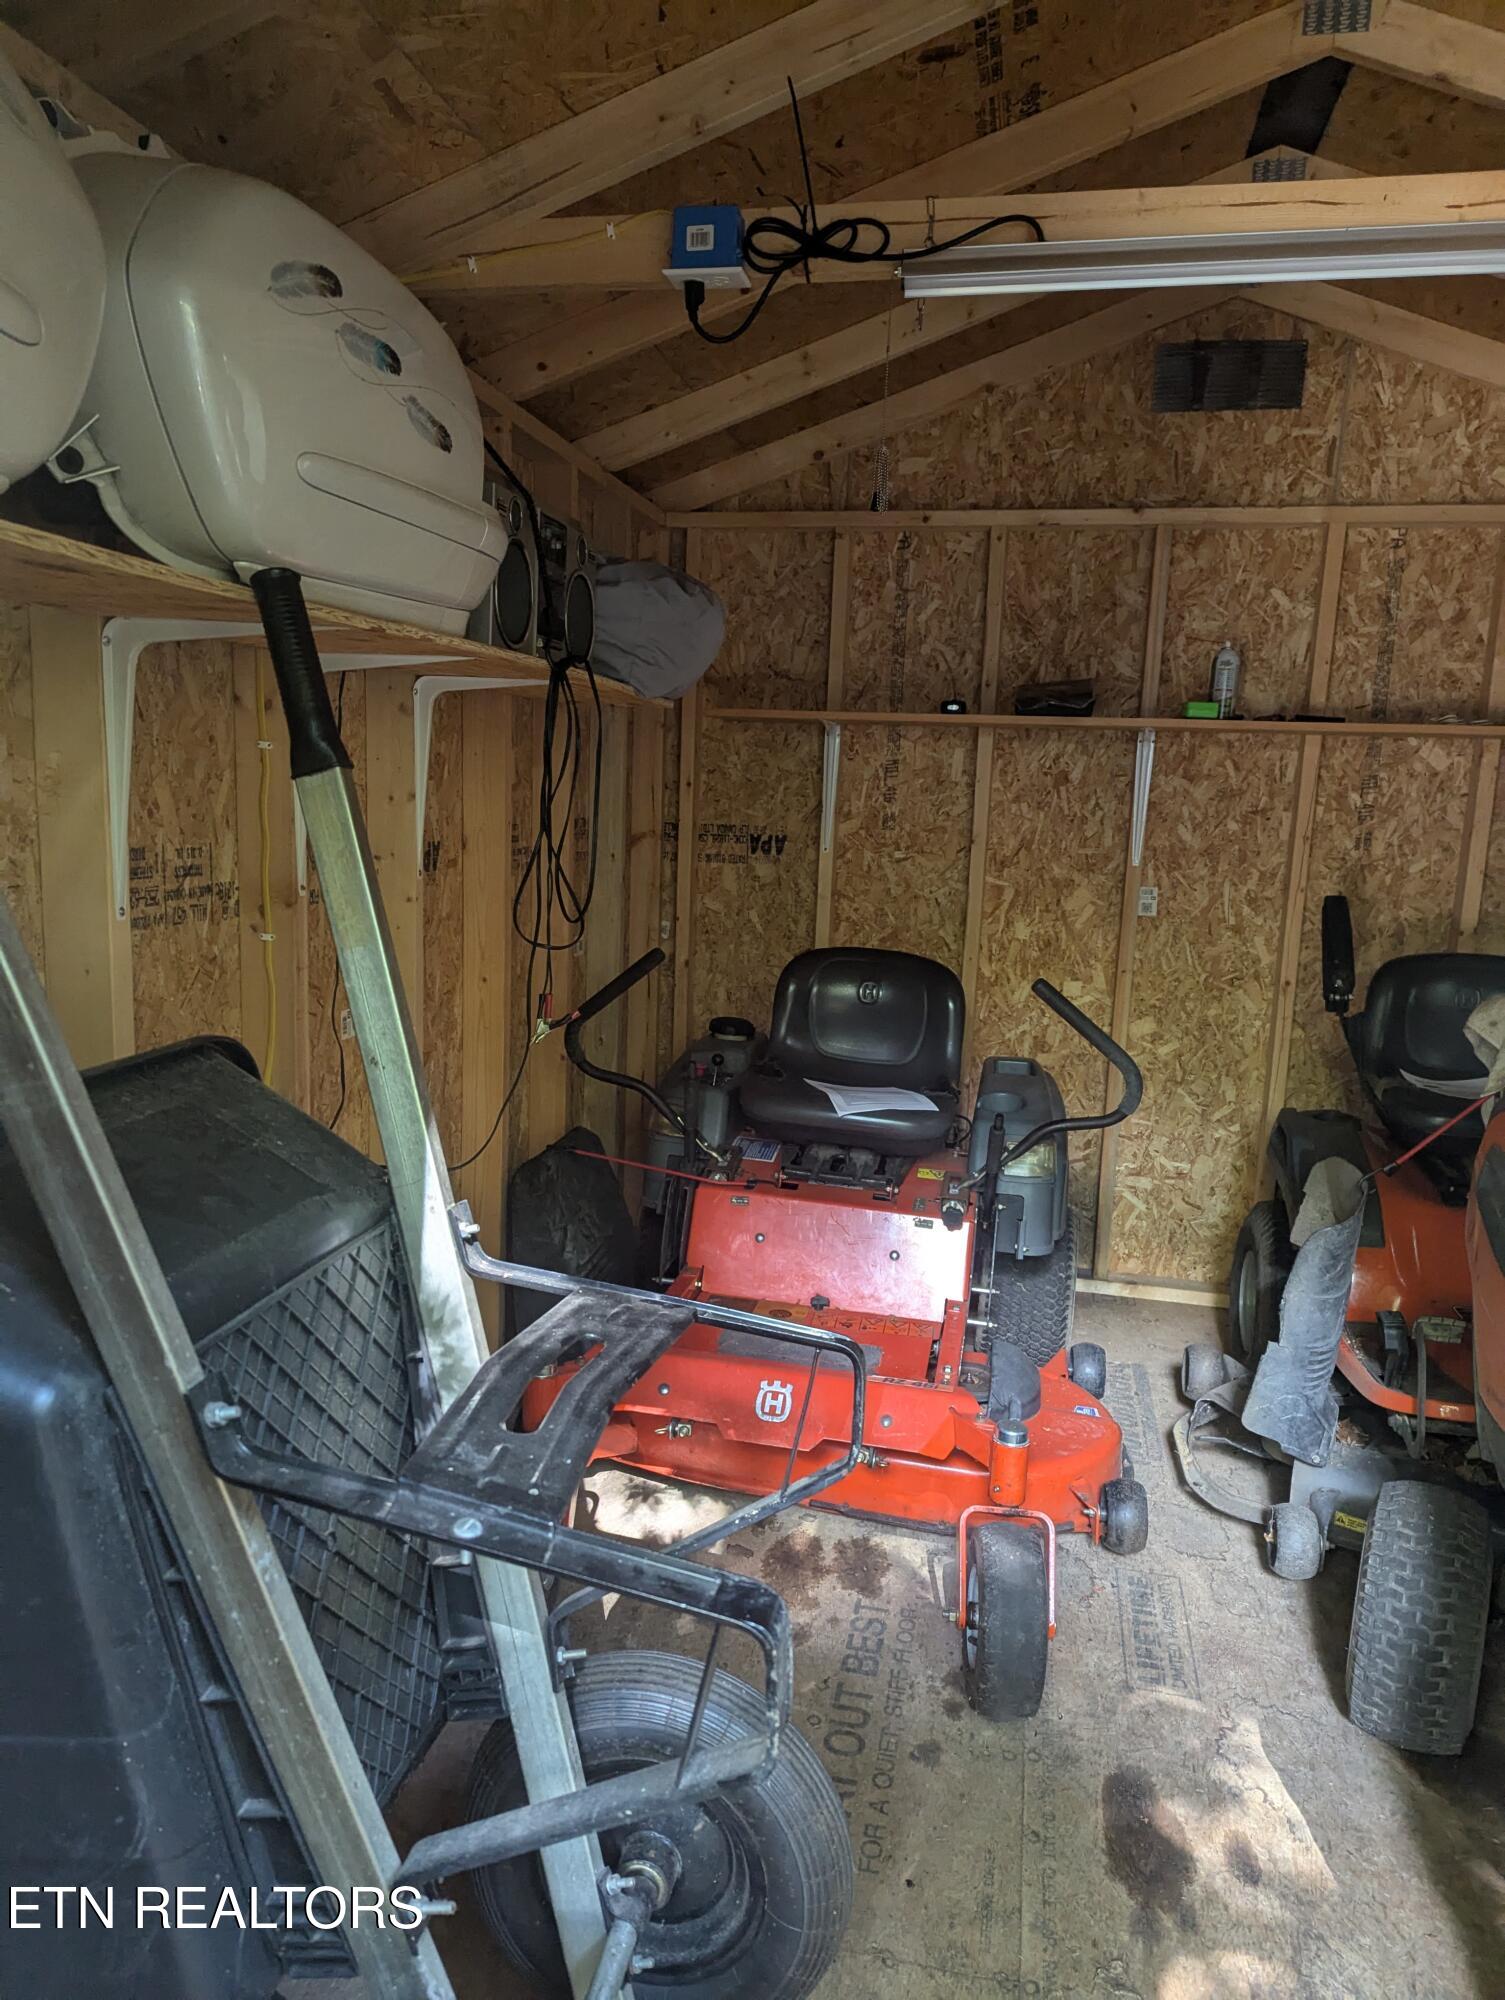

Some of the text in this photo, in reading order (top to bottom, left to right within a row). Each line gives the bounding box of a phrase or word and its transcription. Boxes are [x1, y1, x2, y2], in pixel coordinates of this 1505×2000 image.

[750, 834, 788, 856] APA
[838, 1598, 889, 1677] BEST
[884, 1668, 909, 1717] STIFF
[823, 1681, 874, 1757] OUT
[869, 1800, 891, 1816] A
[857, 1823, 887, 1875] FOR
